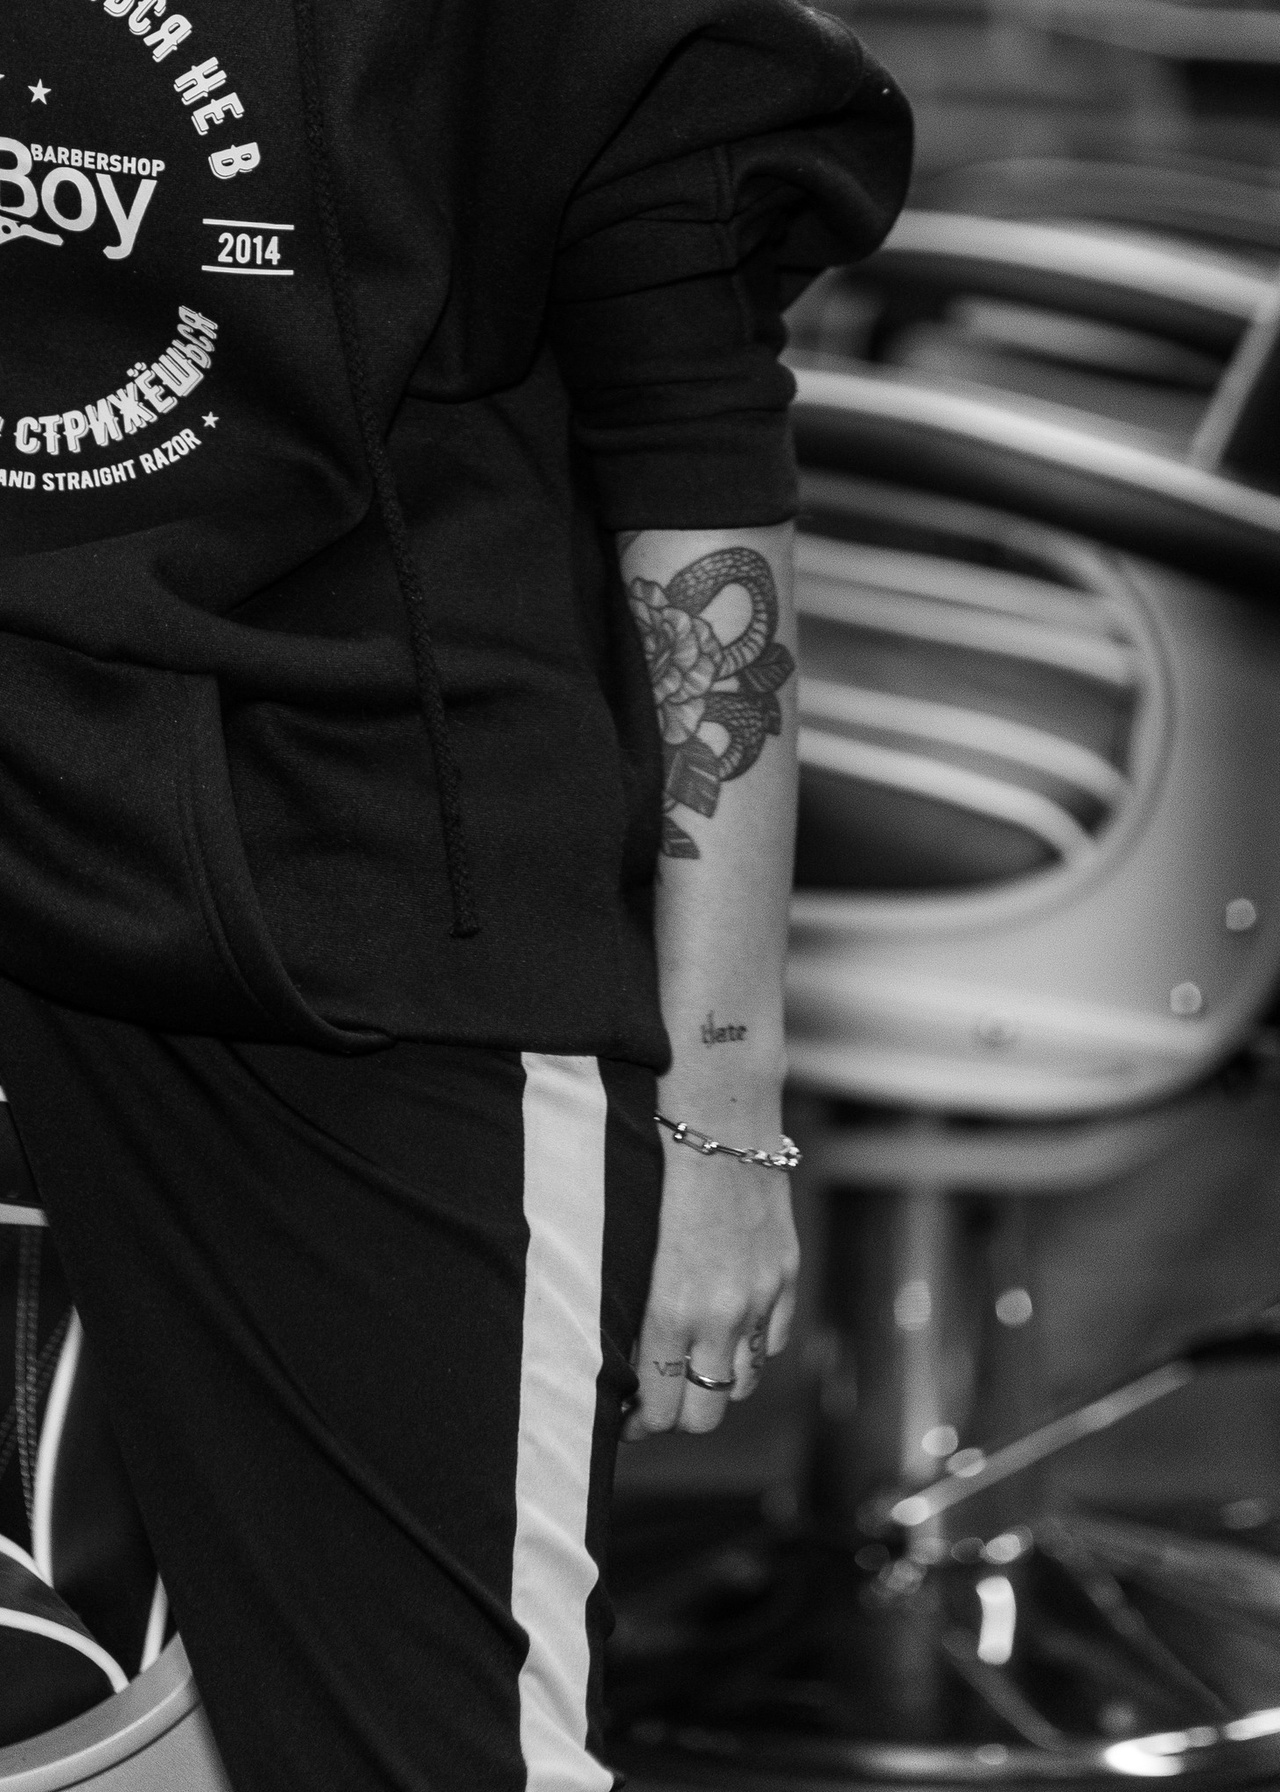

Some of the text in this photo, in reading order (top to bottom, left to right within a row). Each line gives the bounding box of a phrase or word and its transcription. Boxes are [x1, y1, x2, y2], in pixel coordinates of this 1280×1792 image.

[173, 56, 246, 136] НЕ
[30, 142, 167, 178] BARBERSHOP
[207, 141, 262, 181] В
[217, 232, 282, 267] 2014
[14, 304, 219, 455] СТРИЖЁШЬСЯ
[41, 458, 137, 492] STRAIGHT
[138, 427, 203, 475] RAZOR
